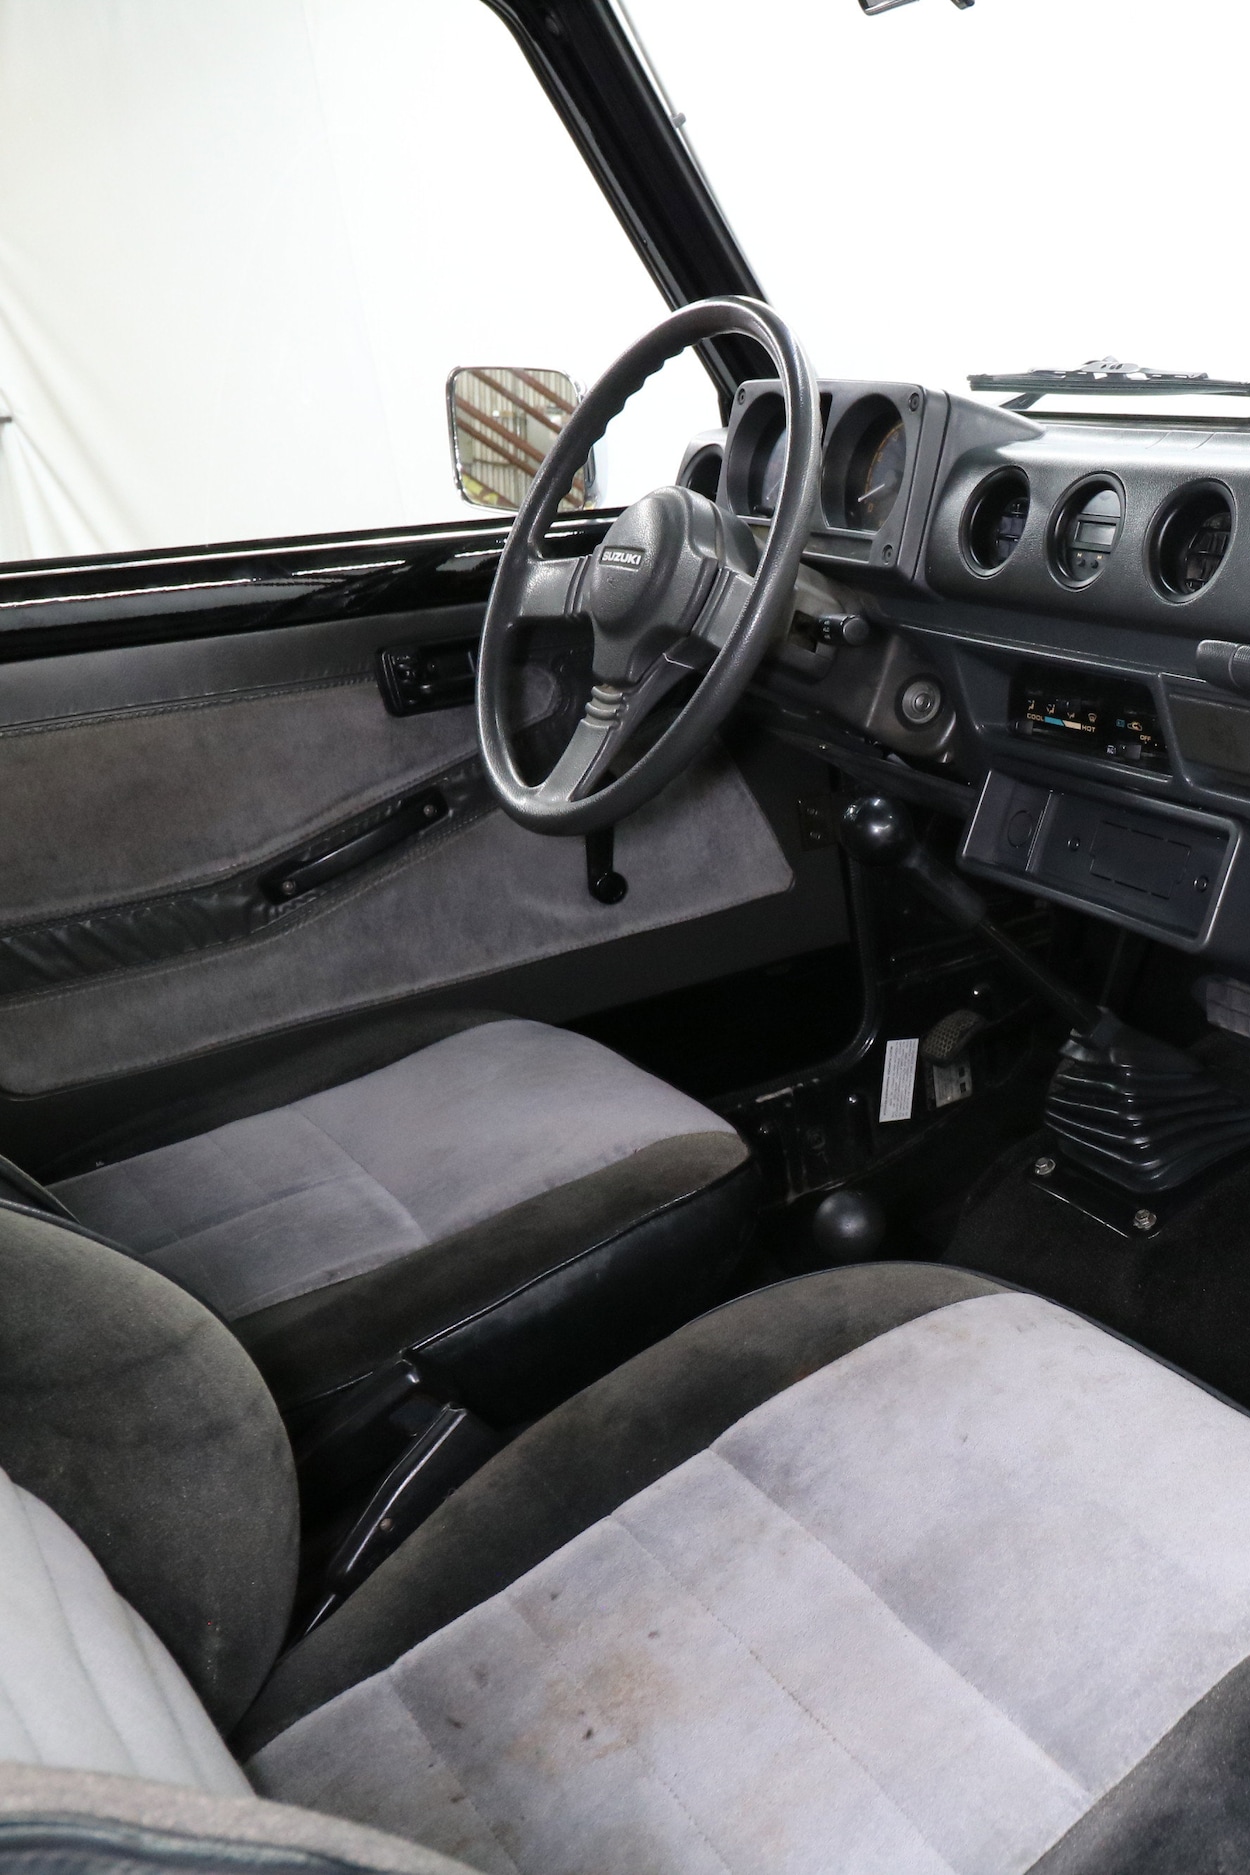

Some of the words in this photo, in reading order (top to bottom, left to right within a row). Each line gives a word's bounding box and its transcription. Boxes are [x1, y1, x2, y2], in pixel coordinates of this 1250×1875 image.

[601, 551, 642, 565] SUZUKI
[1026, 712, 1044, 722] COOL
[1081, 724, 1096, 733] HOT
[1139, 734, 1152, 742] OFF
